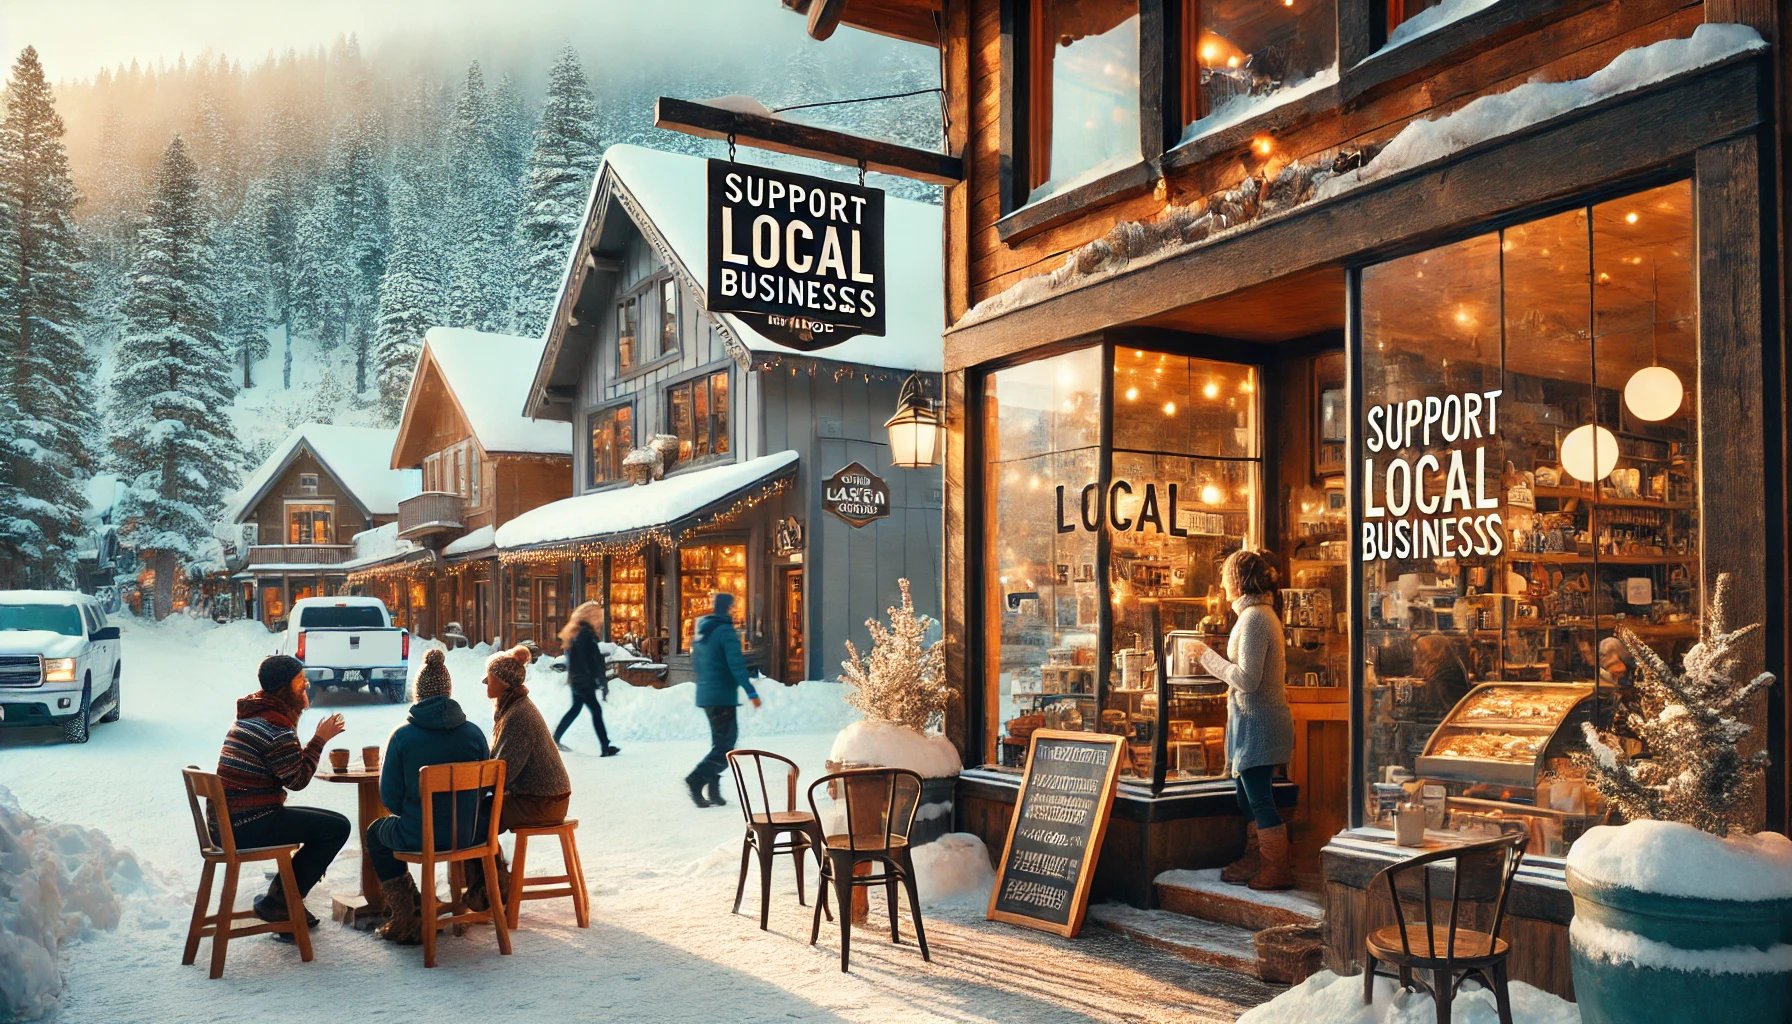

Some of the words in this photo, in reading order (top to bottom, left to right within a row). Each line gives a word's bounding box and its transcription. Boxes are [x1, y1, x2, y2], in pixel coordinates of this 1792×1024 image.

[725, 172, 867, 225] SUPPORT
[721, 205, 874, 284] LOCAL
[721, 267, 876, 318] BUSINESSS
[1366, 389, 1503, 453] SUPPORT
[1055, 479, 1188, 538] LOCAL
[1365, 446, 1499, 518] LOCAL
[1362, 513, 1503, 562] BUSINESSS
